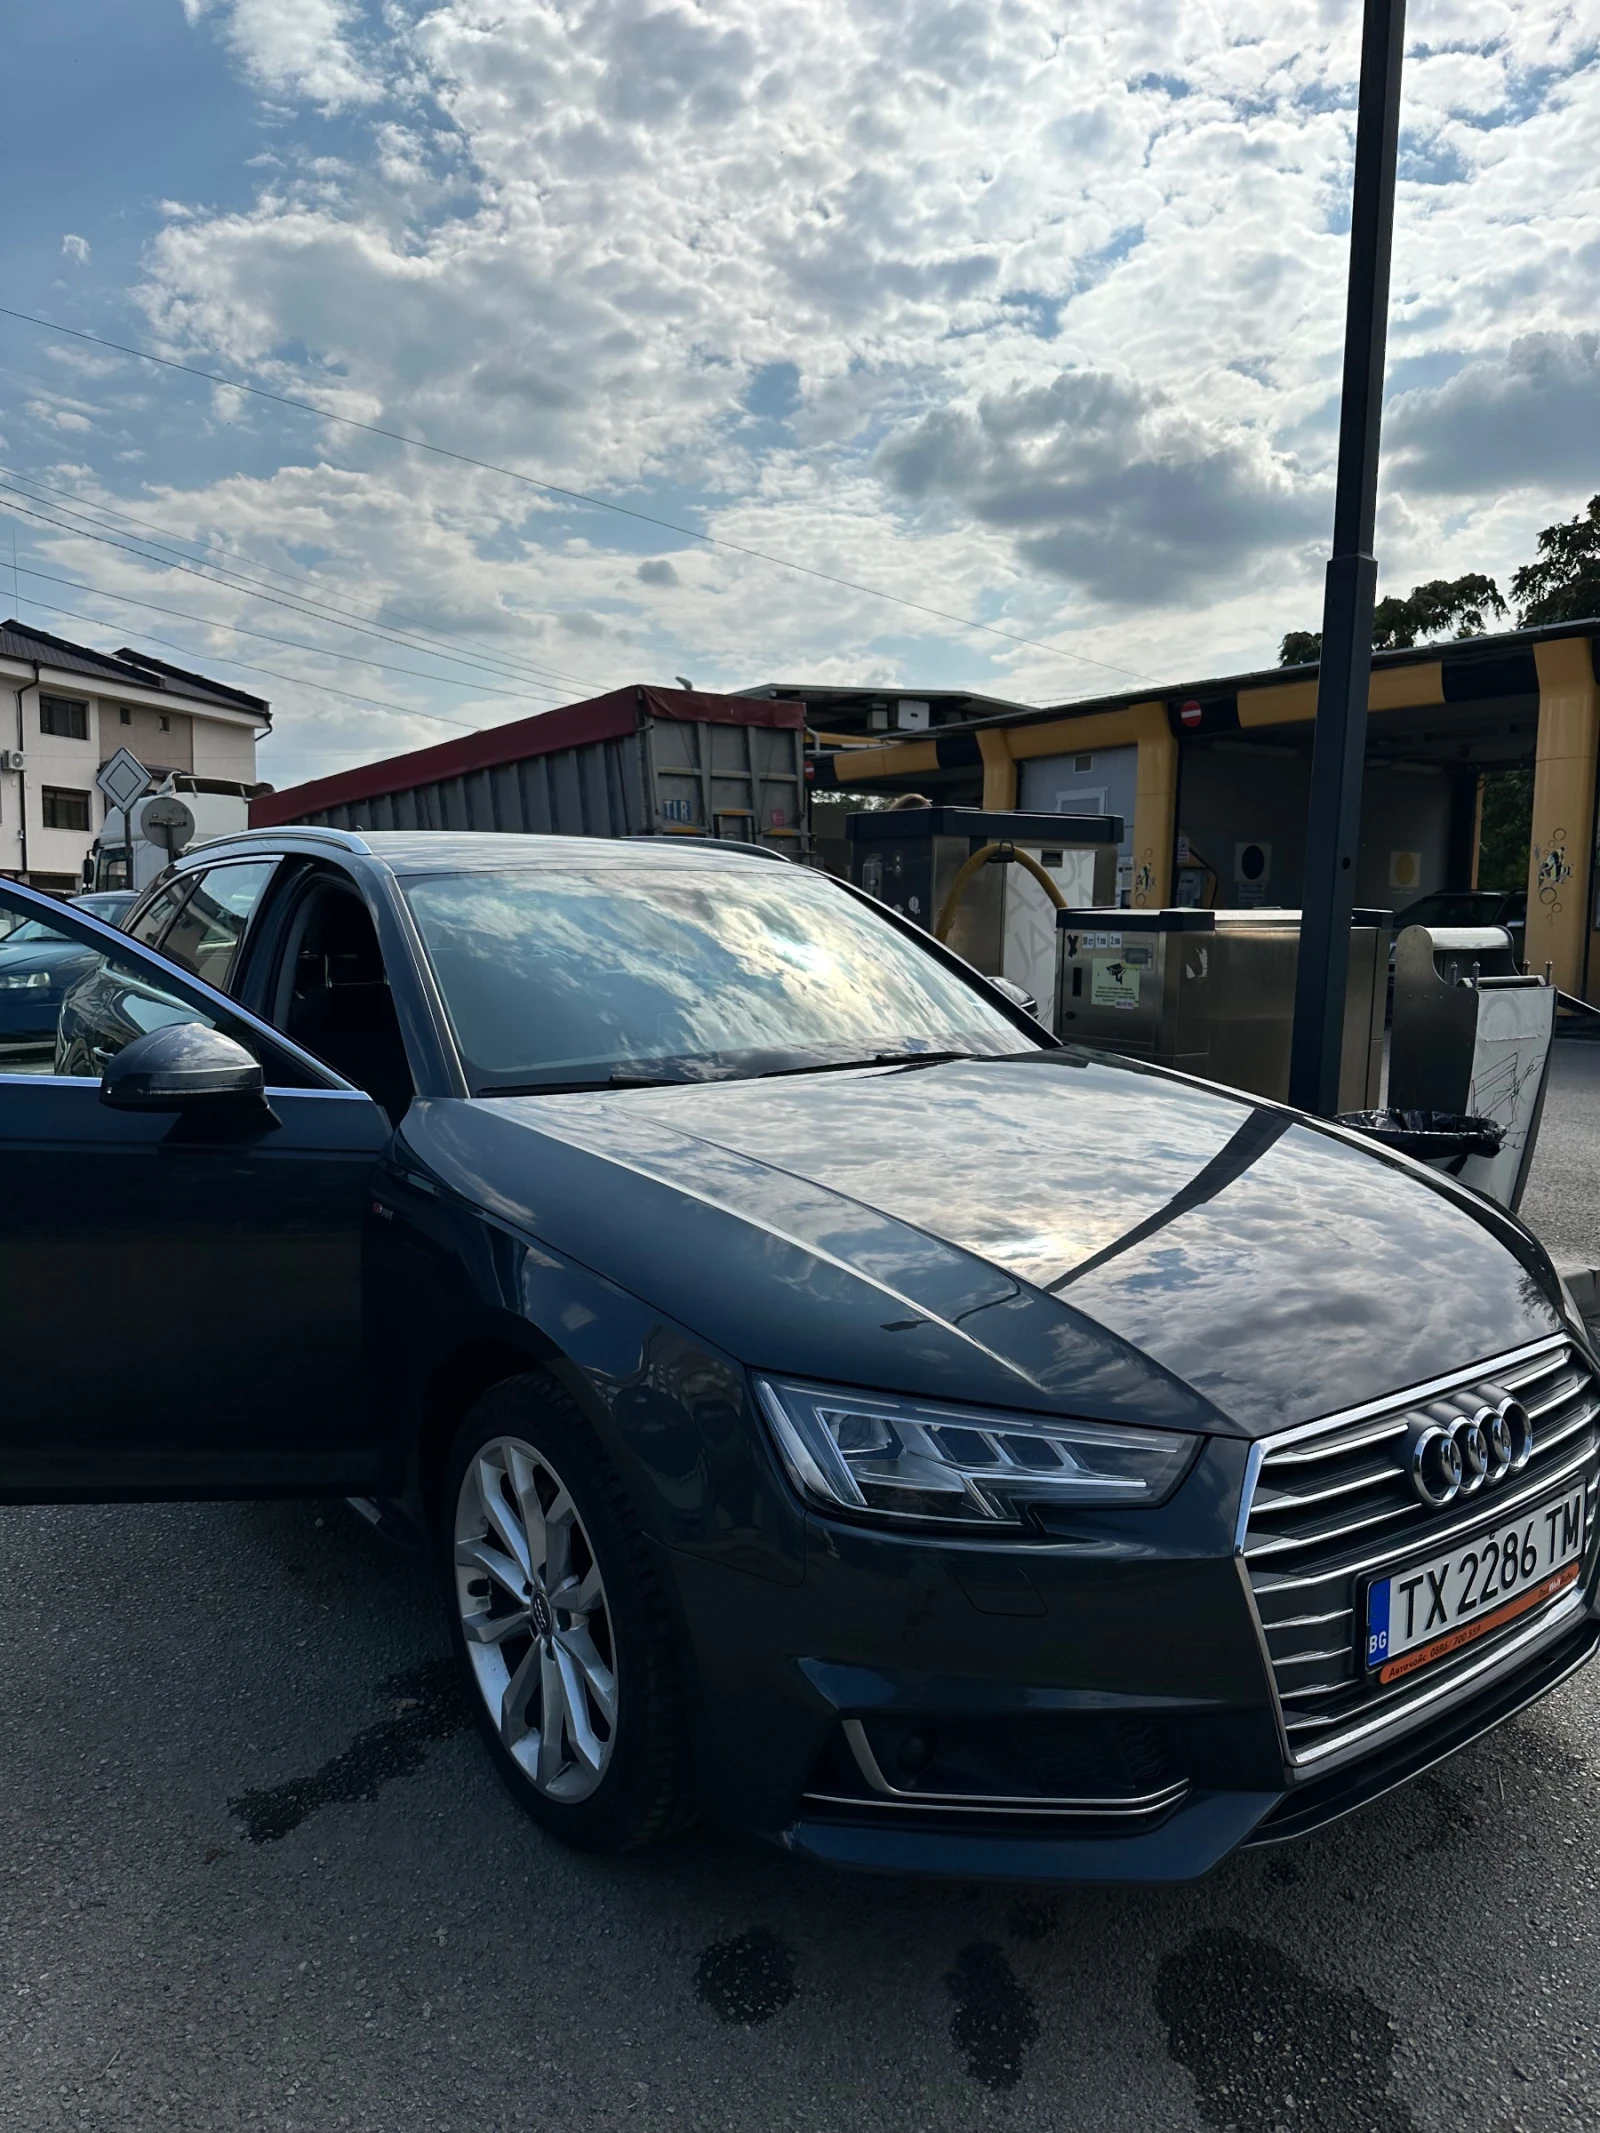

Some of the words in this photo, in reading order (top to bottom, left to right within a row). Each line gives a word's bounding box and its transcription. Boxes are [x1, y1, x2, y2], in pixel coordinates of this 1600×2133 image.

[664, 800, 690, 820] TIR
[1398, 1562, 1450, 1639] TX
[1457, 1520, 1538, 1616] 2286
[1545, 1493, 1581, 1565] TM
[1369, 1631, 1387, 1653] BG
